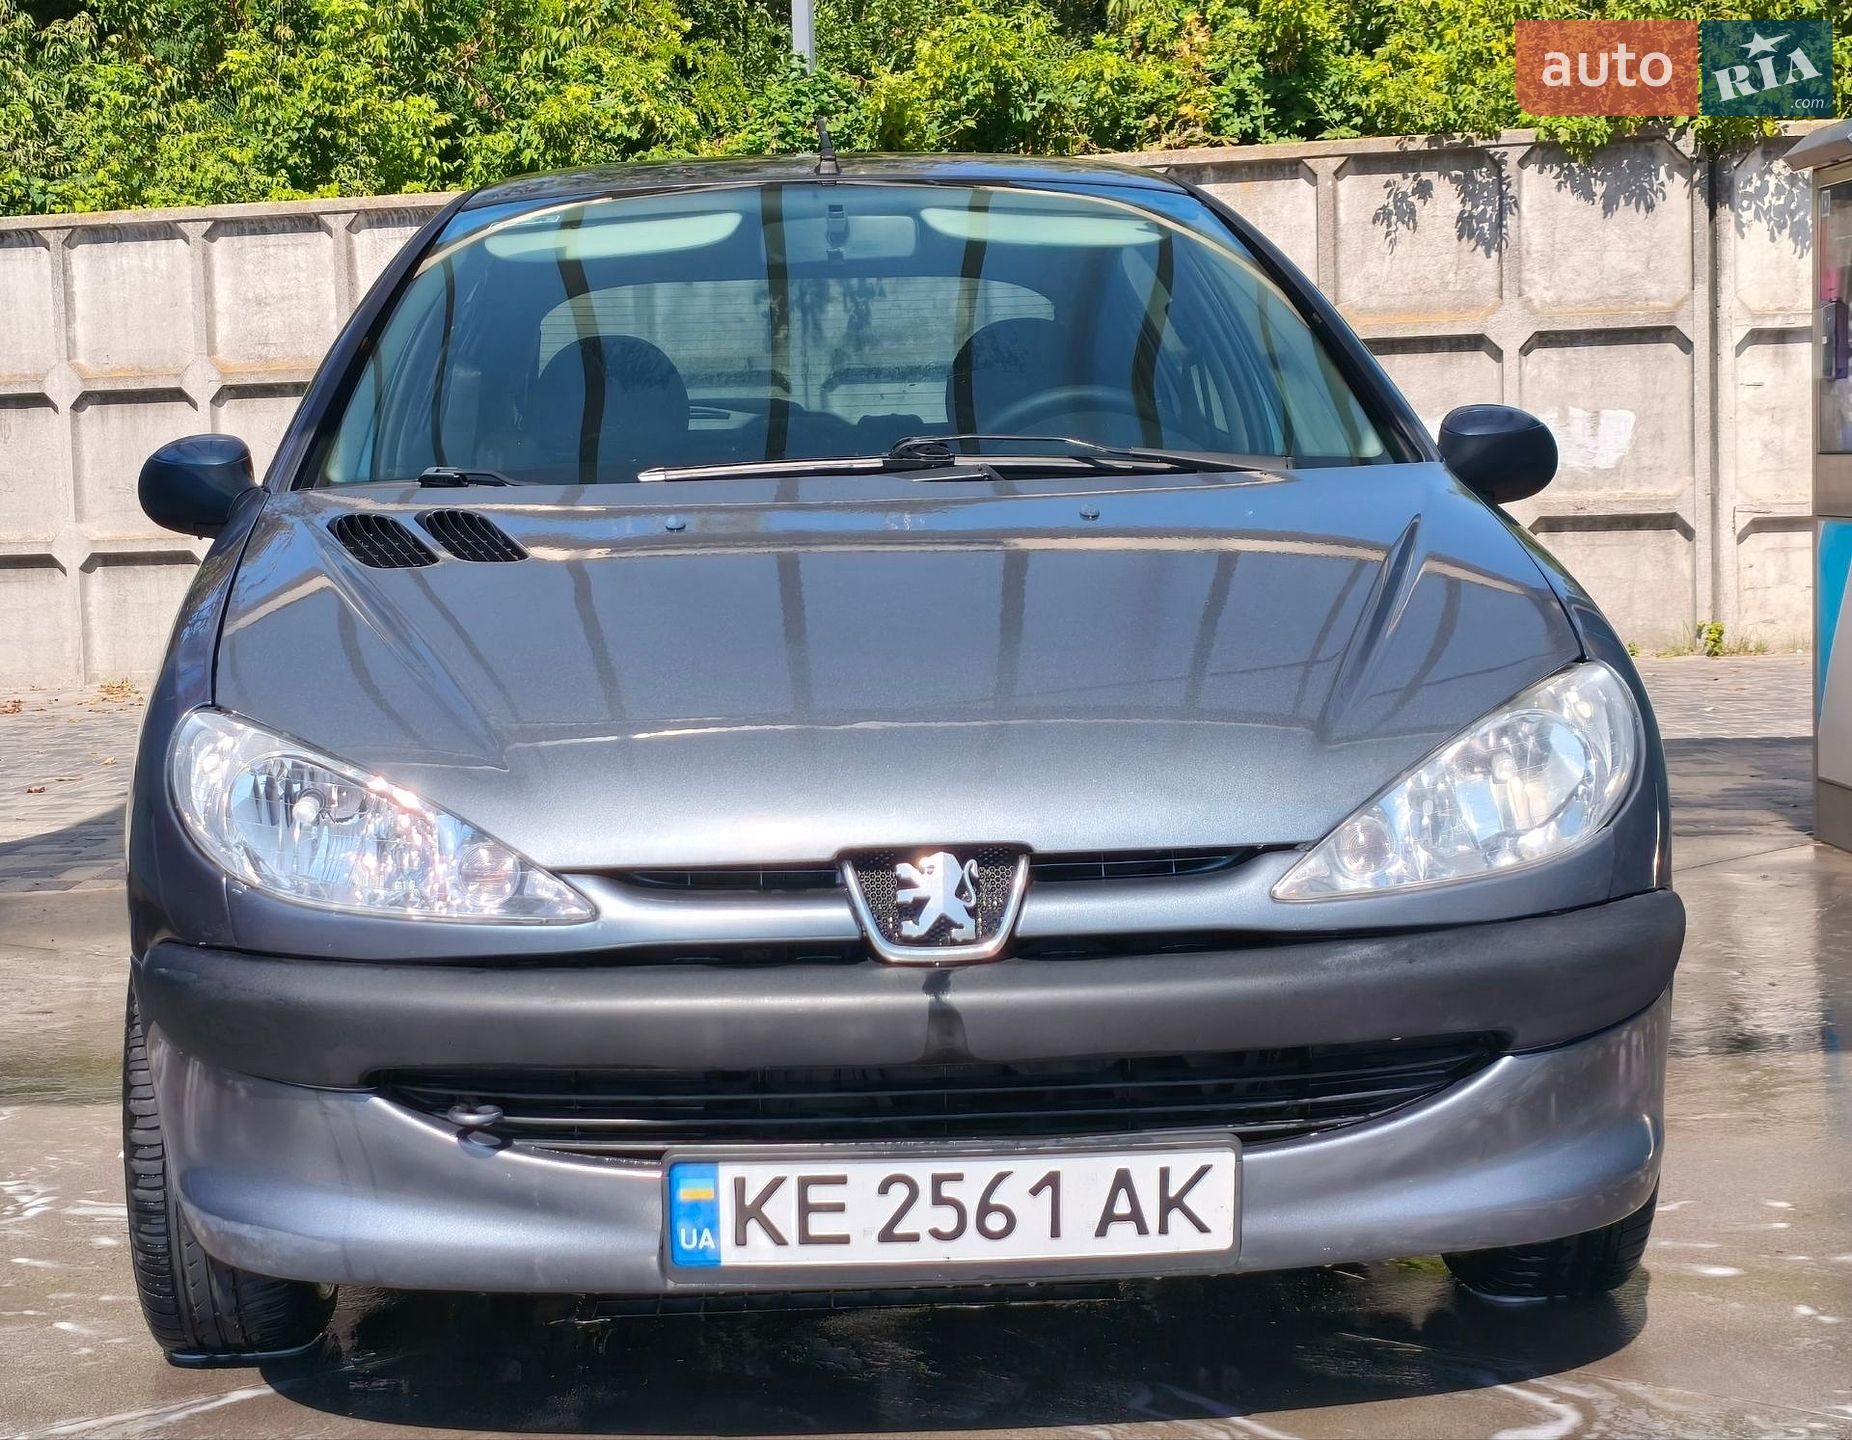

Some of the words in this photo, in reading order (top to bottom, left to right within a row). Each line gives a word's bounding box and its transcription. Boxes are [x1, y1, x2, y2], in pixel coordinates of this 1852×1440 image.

[733, 1174, 851, 1247] KE
[877, 1170, 1061, 1243] 2561
[1094, 1164, 1213, 1238] AK
[680, 1227, 716, 1250] UA
